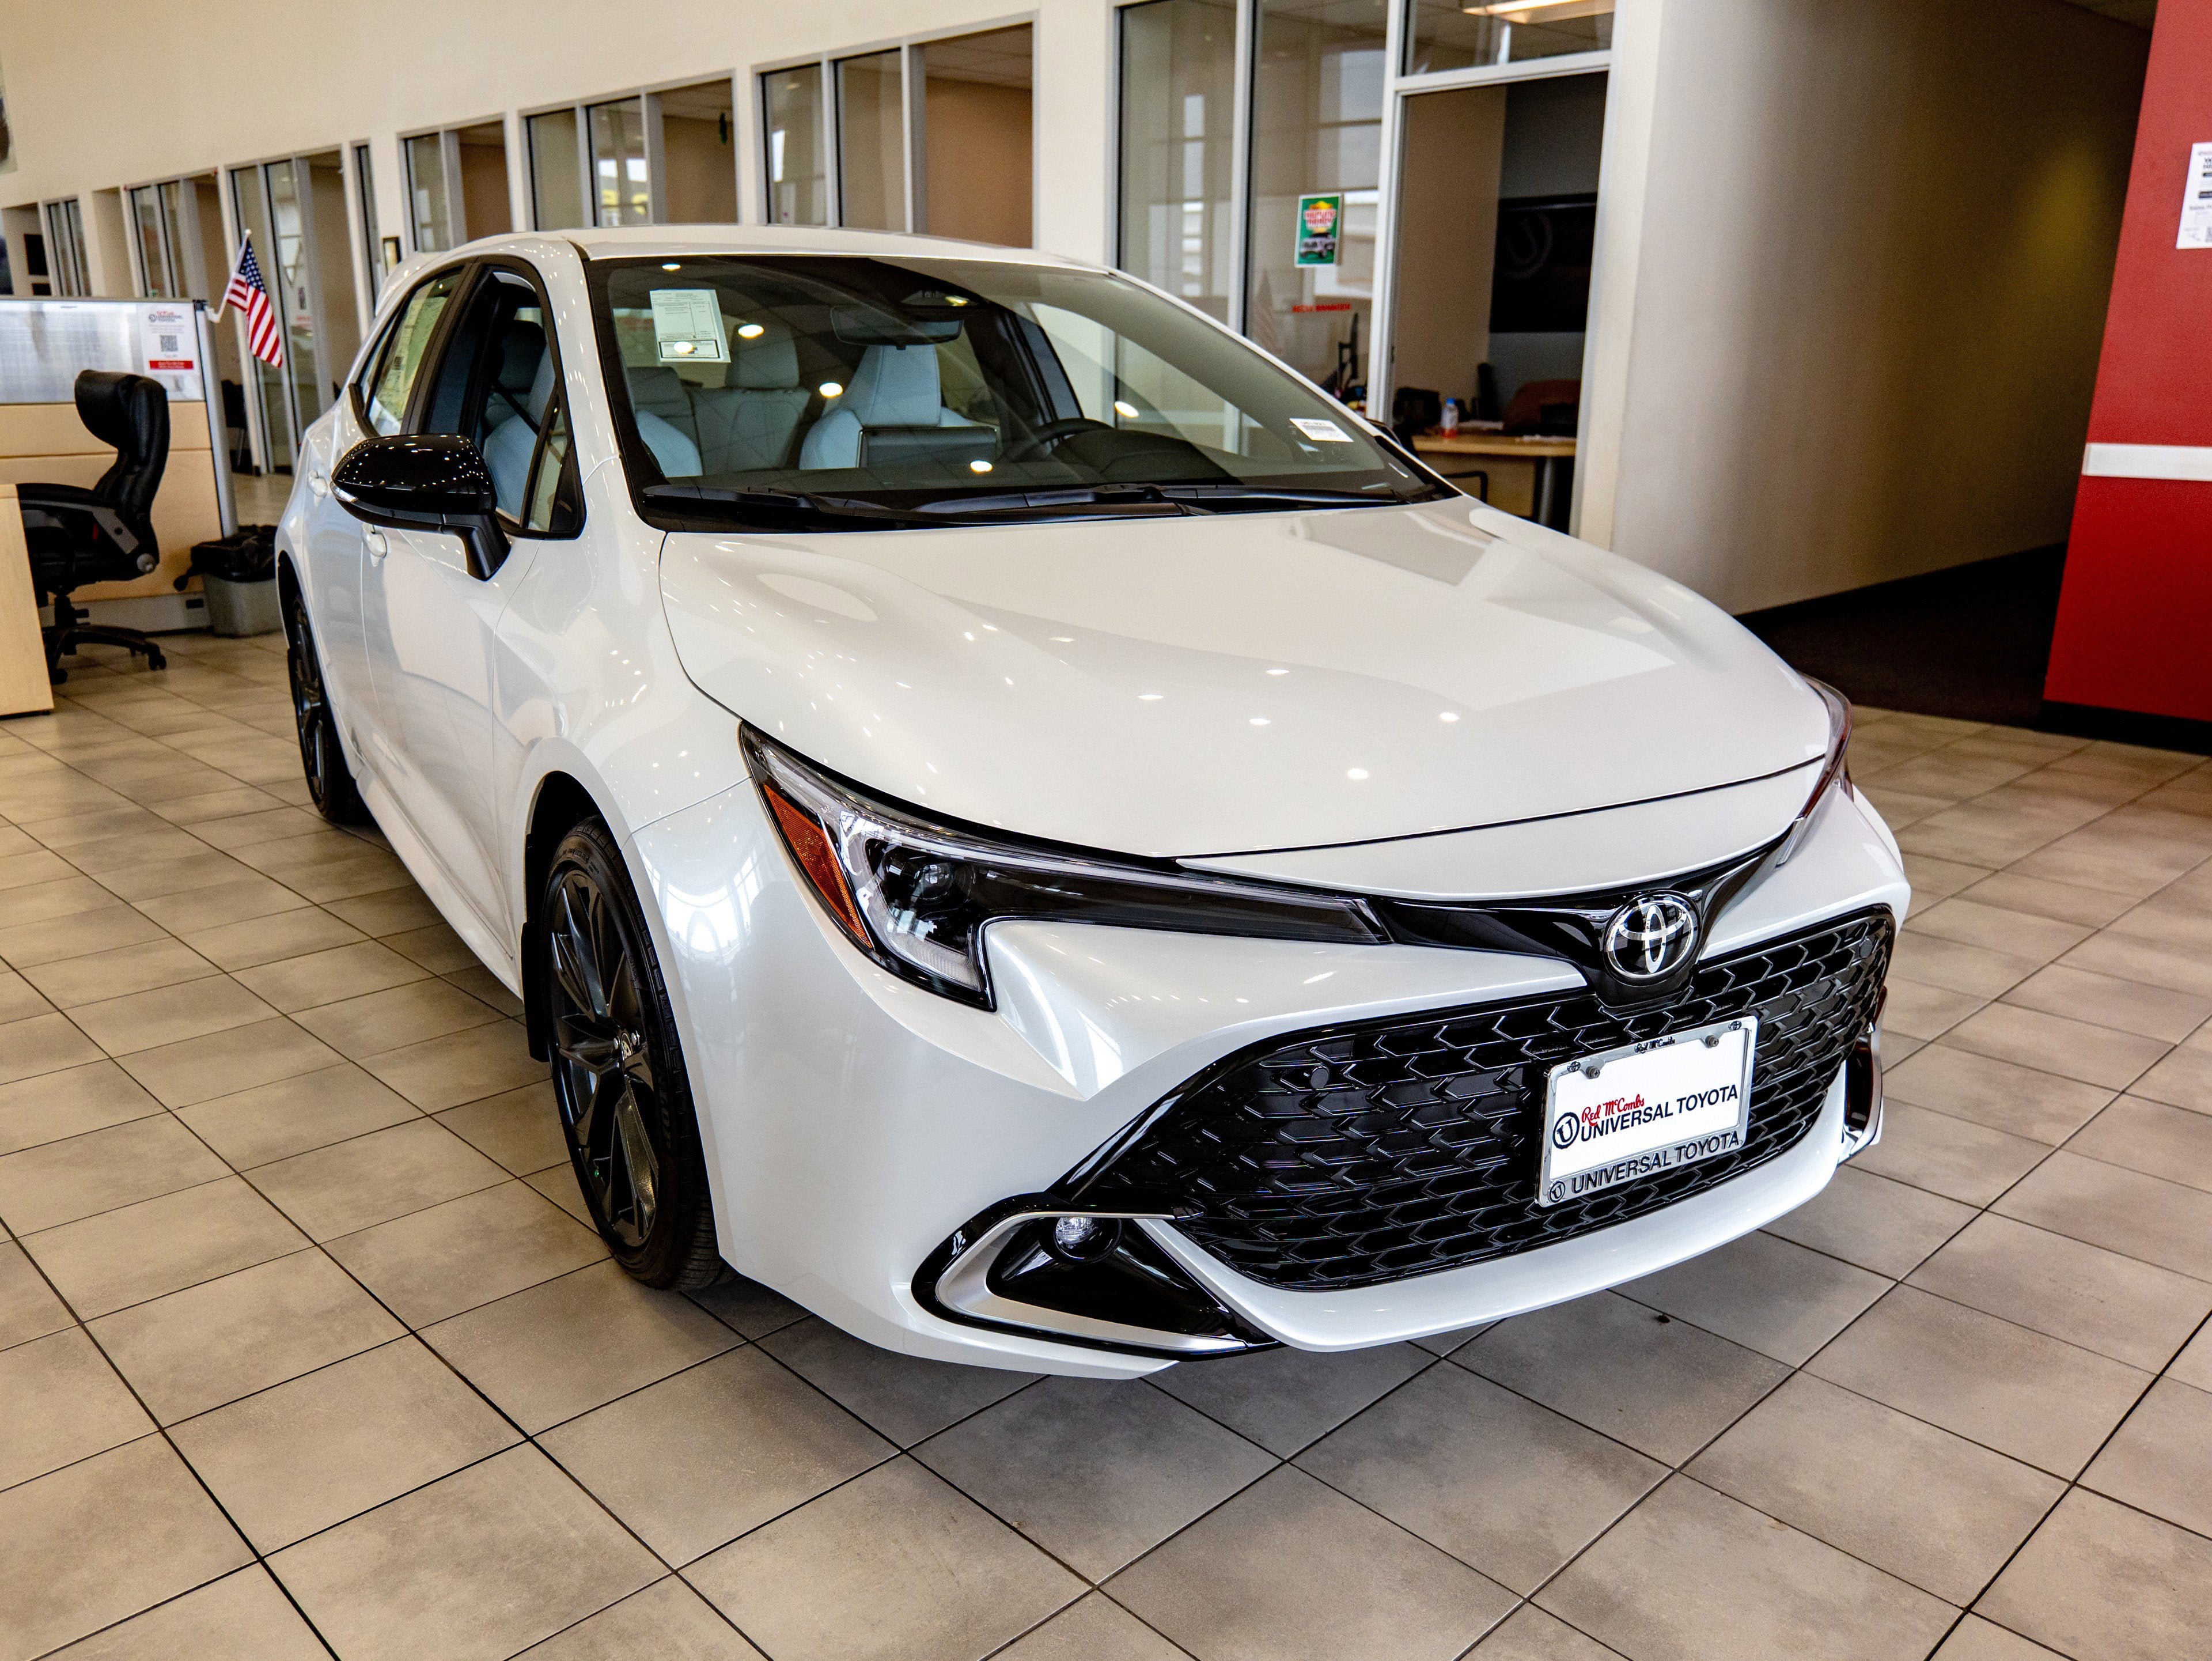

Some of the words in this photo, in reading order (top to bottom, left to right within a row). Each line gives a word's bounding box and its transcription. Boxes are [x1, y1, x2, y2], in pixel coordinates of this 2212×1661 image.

[1581, 1106, 1601, 1126] Red
[1603, 1094, 1645, 1117] McCombs
[1581, 1102, 1673, 1142] UNIVERSAL
[1676, 1084, 1738, 1114] TOYOTA
[1571, 1150, 1672, 1194] UNIVERSAL
[1674, 1130, 1739, 1163] TOYOTA
